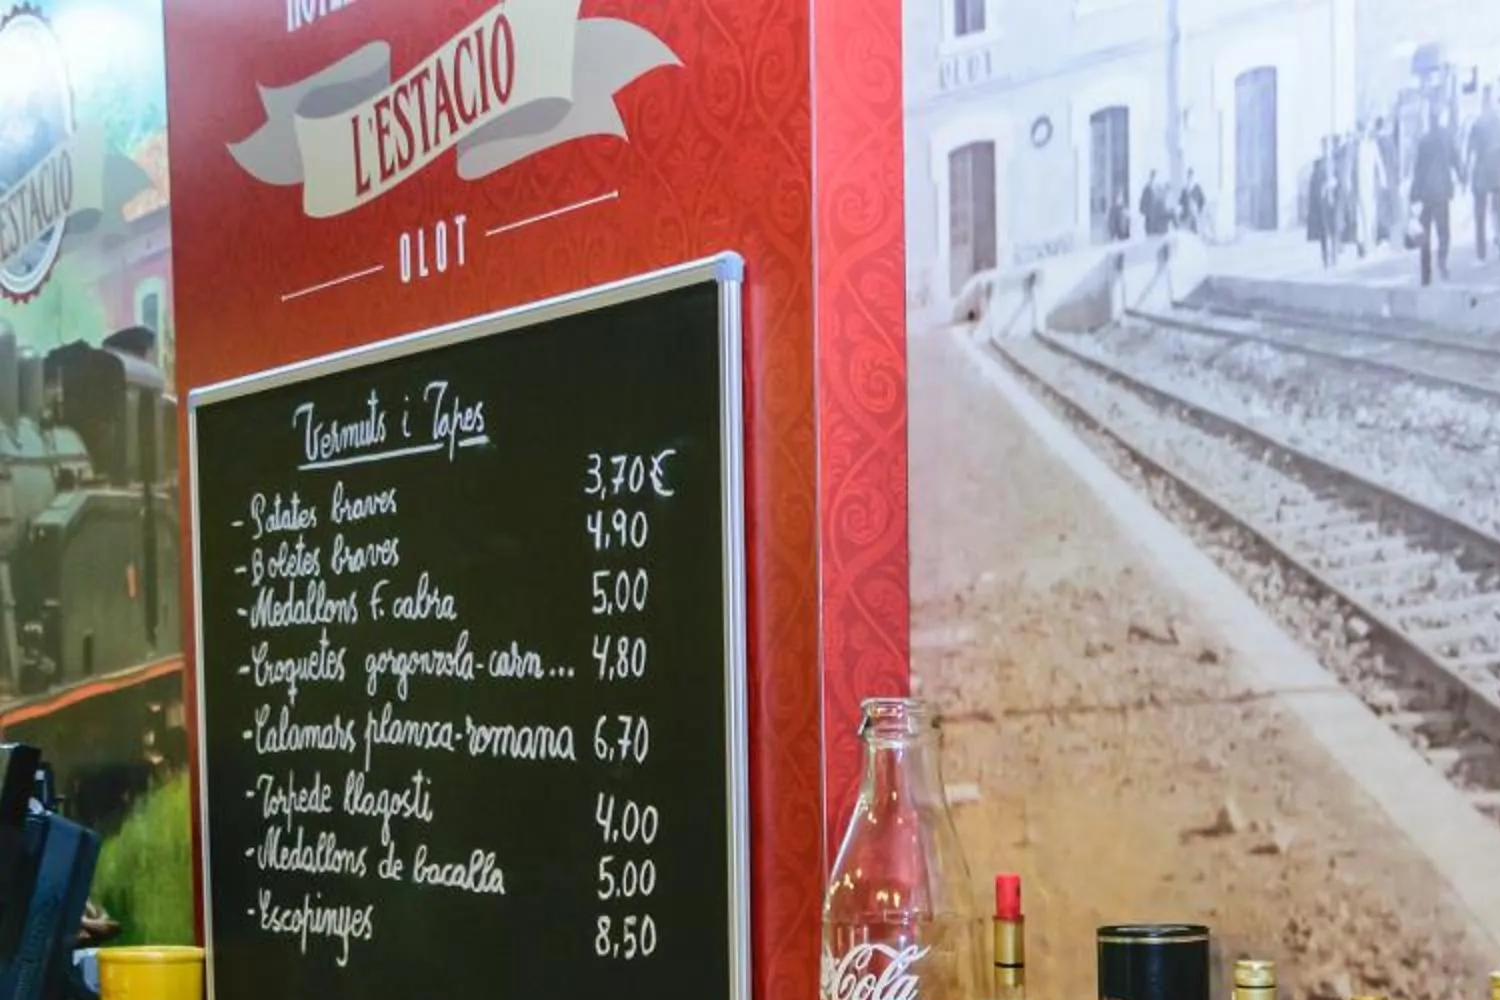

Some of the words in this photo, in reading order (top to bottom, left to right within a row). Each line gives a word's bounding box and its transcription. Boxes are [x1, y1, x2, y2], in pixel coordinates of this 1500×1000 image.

[351, 13, 515, 197] L'ESTACIO
[399, 214, 467, 283] OLOT
[293, 389, 387, 461] Vermuts
[402, 395, 411, 437] i
[423, 381, 487, 461] Tapes
[331, 480, 397, 524] braves
[331, 532, 399, 574] braves
[587, 508, 648, 550] 4,90
[393, 571, 458, 620] cabra
[592, 568, 649, 615] 5,00
[592, 635, 647, 681] 4,80
[594, 715, 649, 764] 6,70
[378, 840, 402, 881] de
[412, 844, 506, 895] bacalla
[595, 914, 656, 959] 8,50
